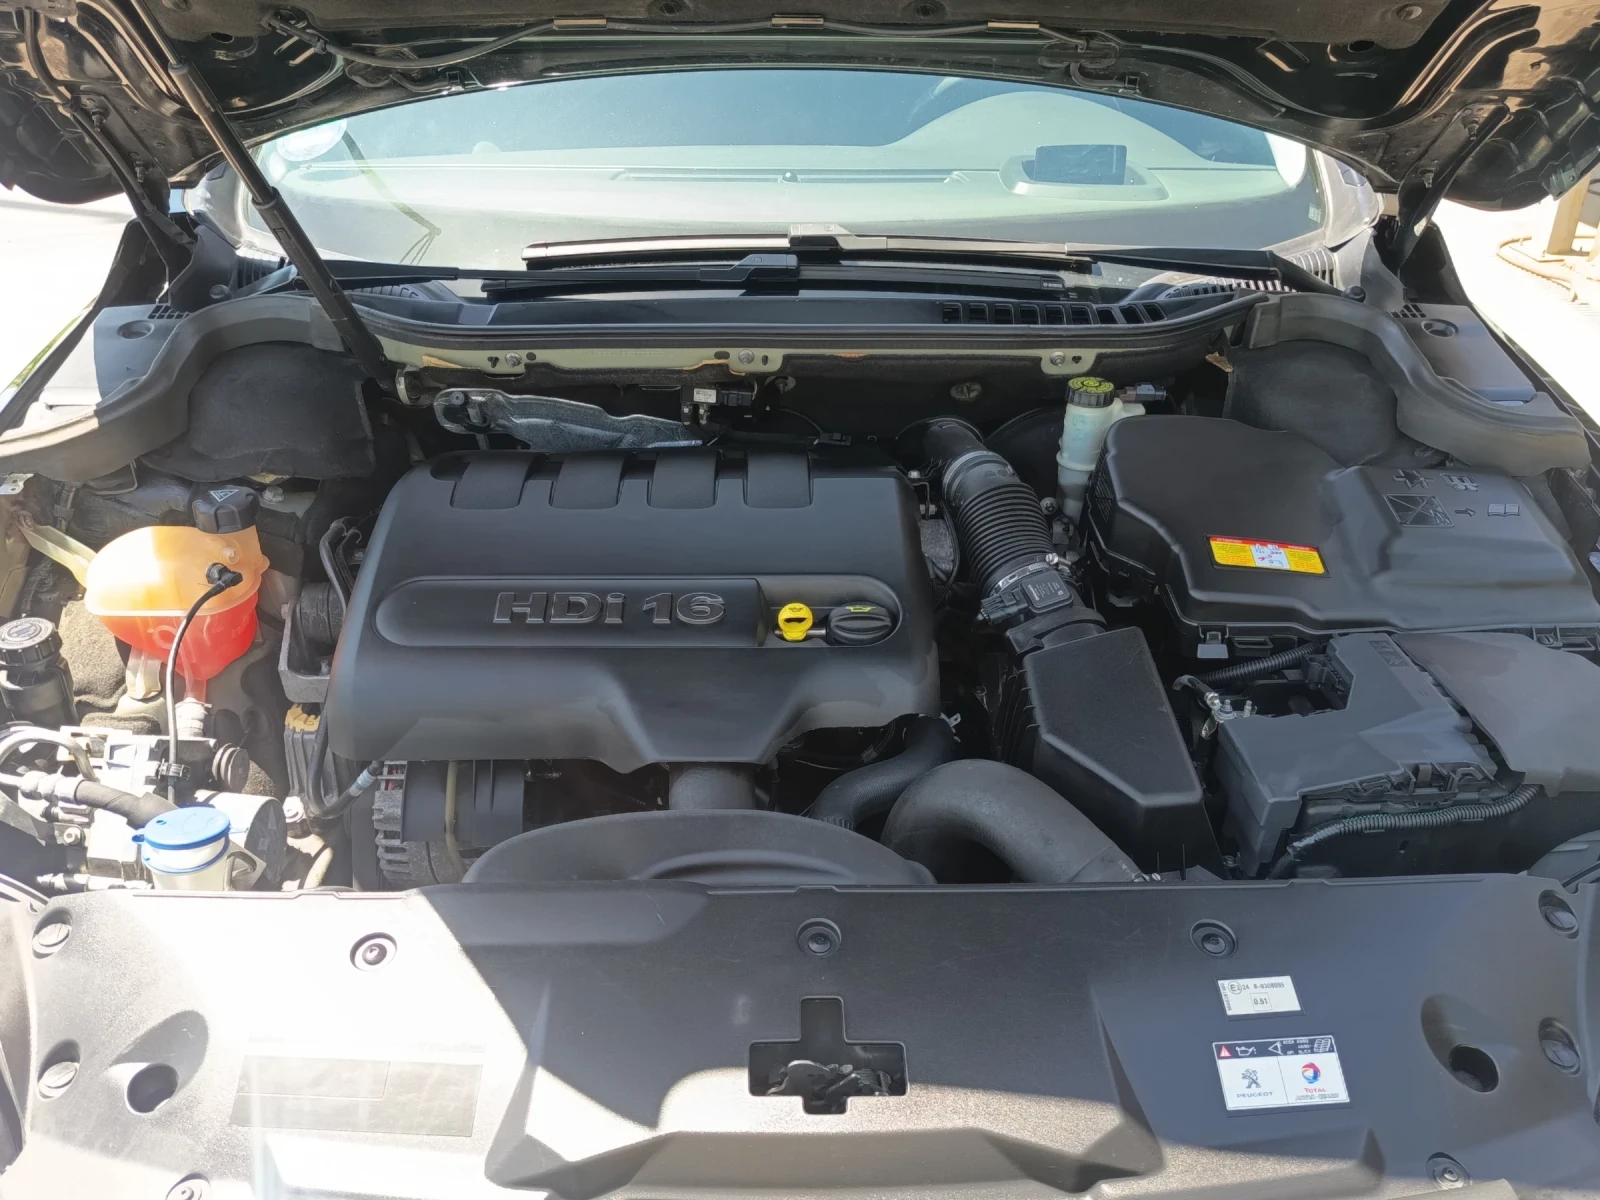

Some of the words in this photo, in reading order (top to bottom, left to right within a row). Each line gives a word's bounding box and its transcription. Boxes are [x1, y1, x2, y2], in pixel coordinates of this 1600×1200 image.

[493, 592, 626, 623] HDi
[643, 592, 725, 624] 16
[1253, 998, 1268, 1006] 0.51
